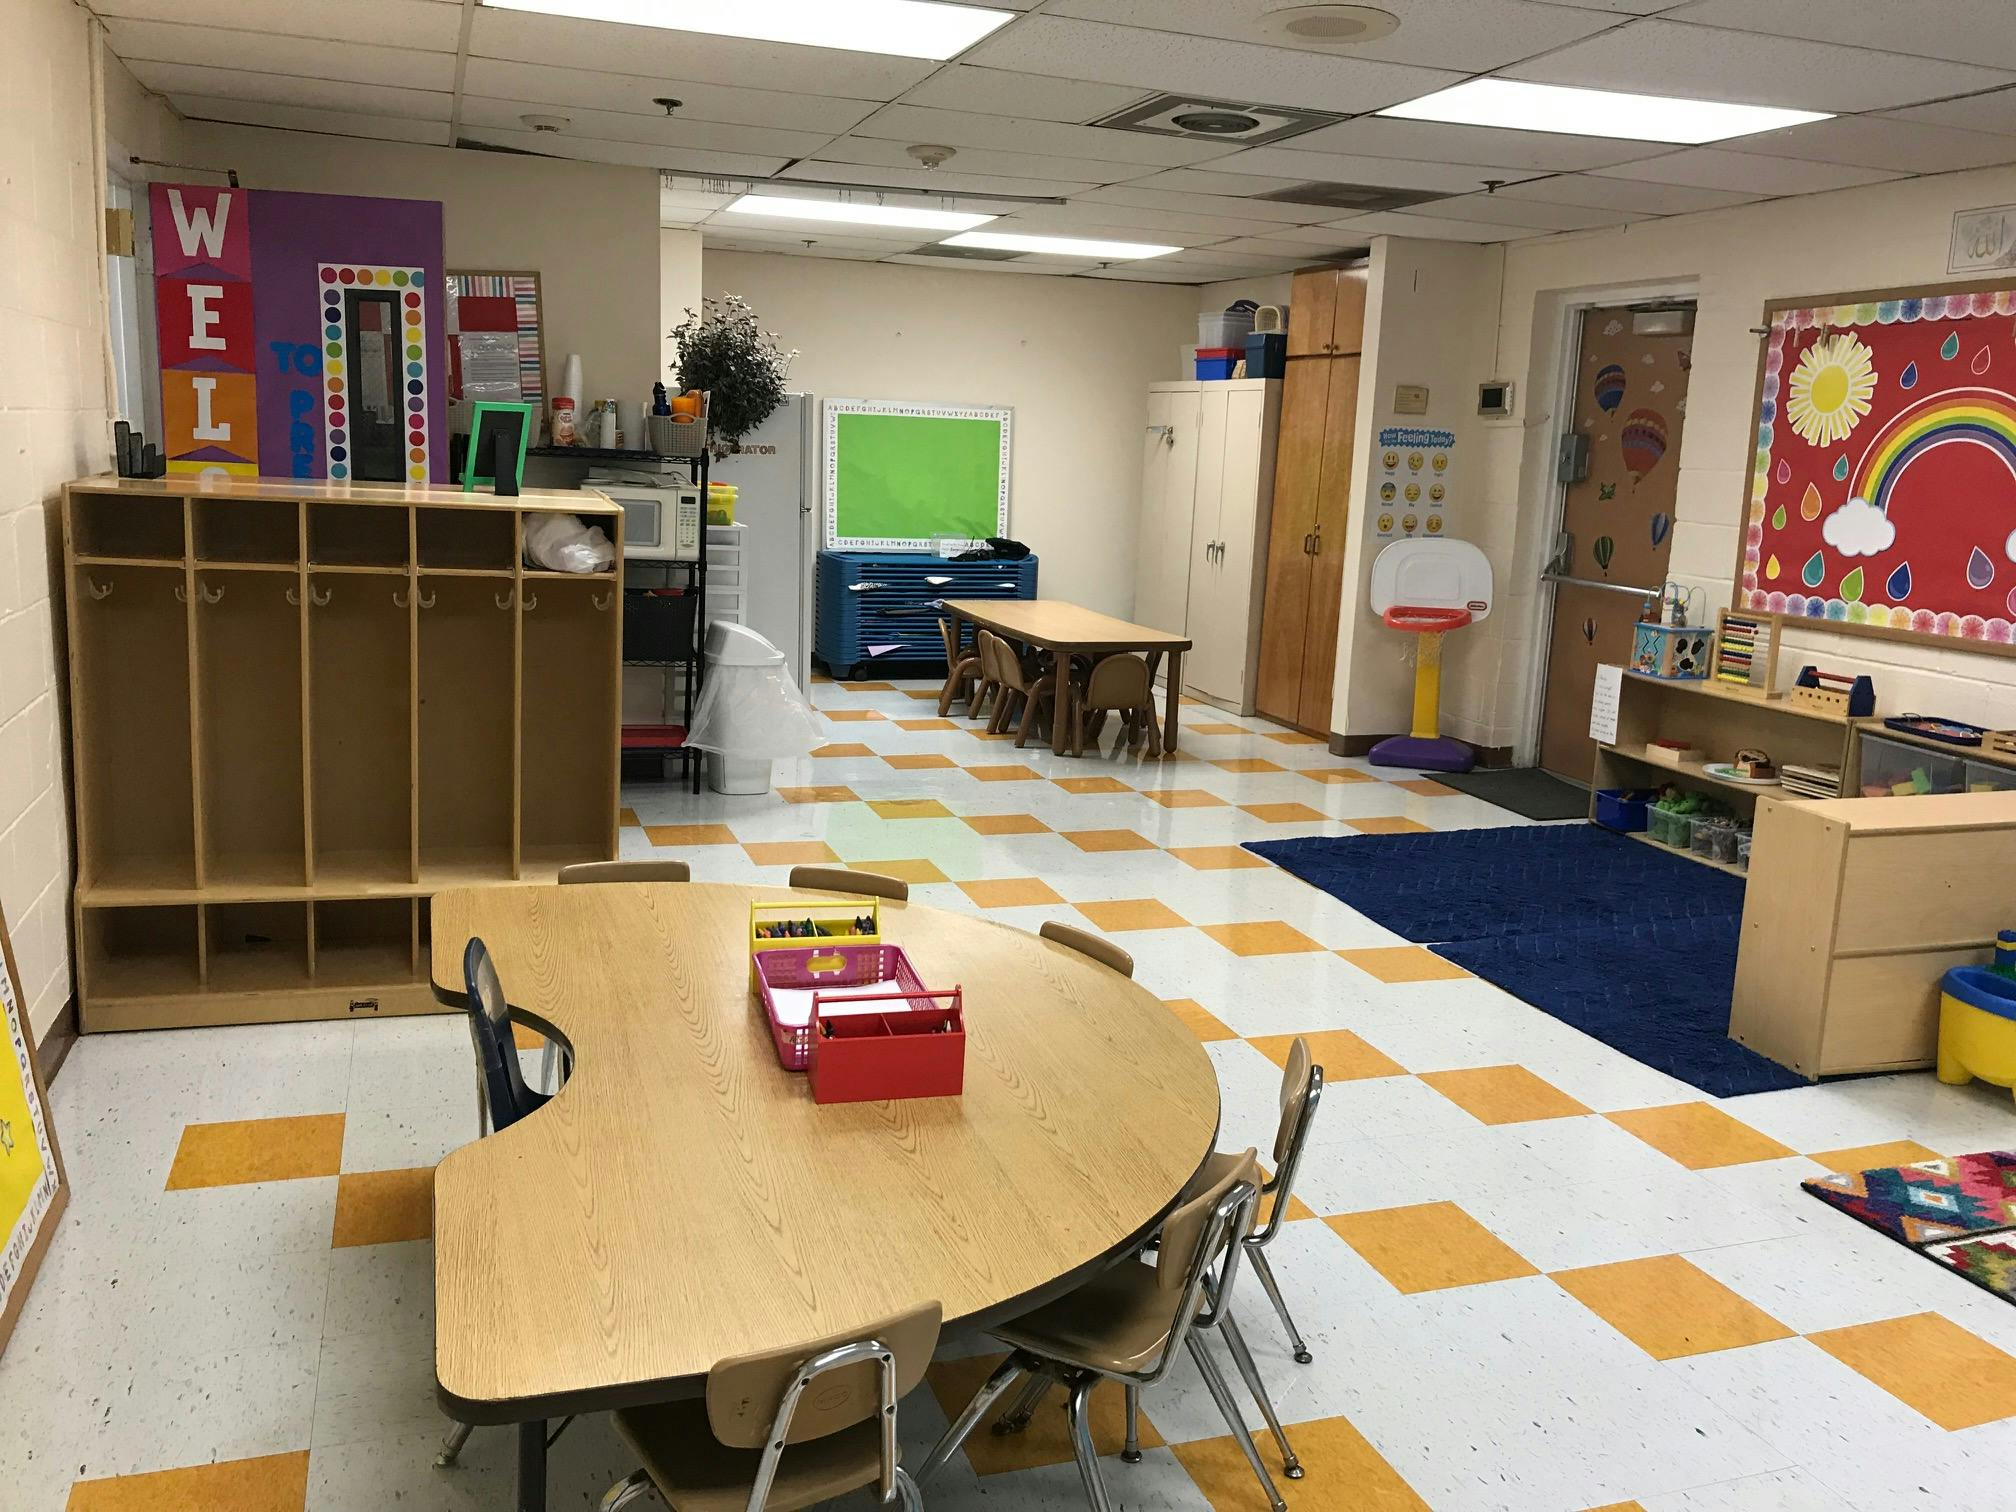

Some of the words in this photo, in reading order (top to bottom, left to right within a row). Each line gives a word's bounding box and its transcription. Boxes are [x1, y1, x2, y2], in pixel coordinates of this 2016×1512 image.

[166, 187, 232, 476] WEL
[270, 341, 323, 377] TO
[1397, 431, 1430, 444] Feeling
